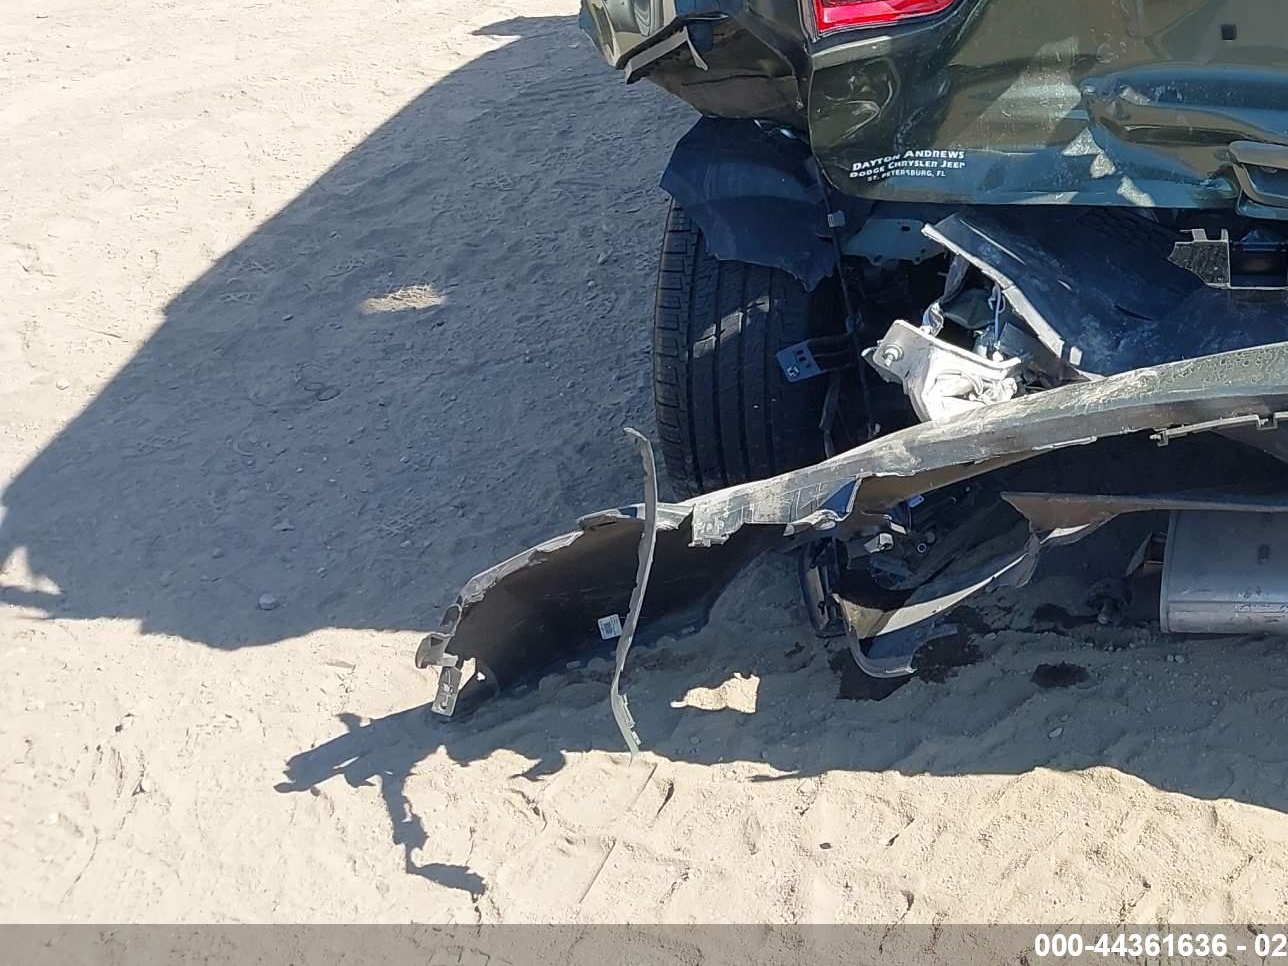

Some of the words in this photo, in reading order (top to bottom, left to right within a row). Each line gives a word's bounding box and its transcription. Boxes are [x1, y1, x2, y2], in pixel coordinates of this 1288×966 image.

[849, 167, 886, 178] DODGE
[887, 160, 938, 170] CHRYSLER
[940, 160, 966, 169] JEEP
[852, 153, 901, 171] DAYTON
[903, 150, 965, 159] ANDREWS
